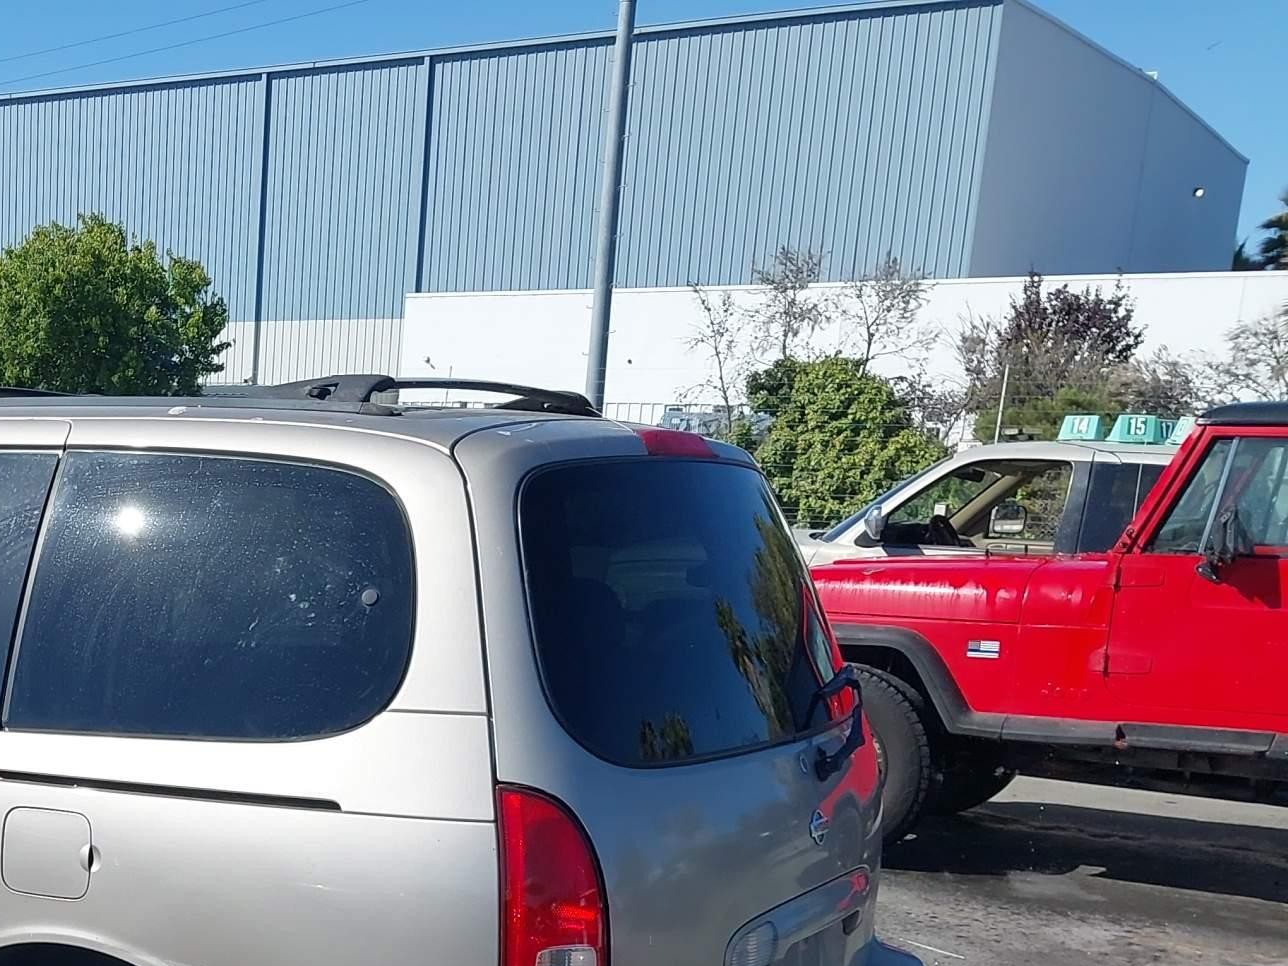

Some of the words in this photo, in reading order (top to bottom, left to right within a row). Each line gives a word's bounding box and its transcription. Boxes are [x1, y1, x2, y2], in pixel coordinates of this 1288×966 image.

[1073, 417, 1089, 434] 14
[1129, 417, 1146, 436] 15
[1161, 421, 1173, 440] 17
